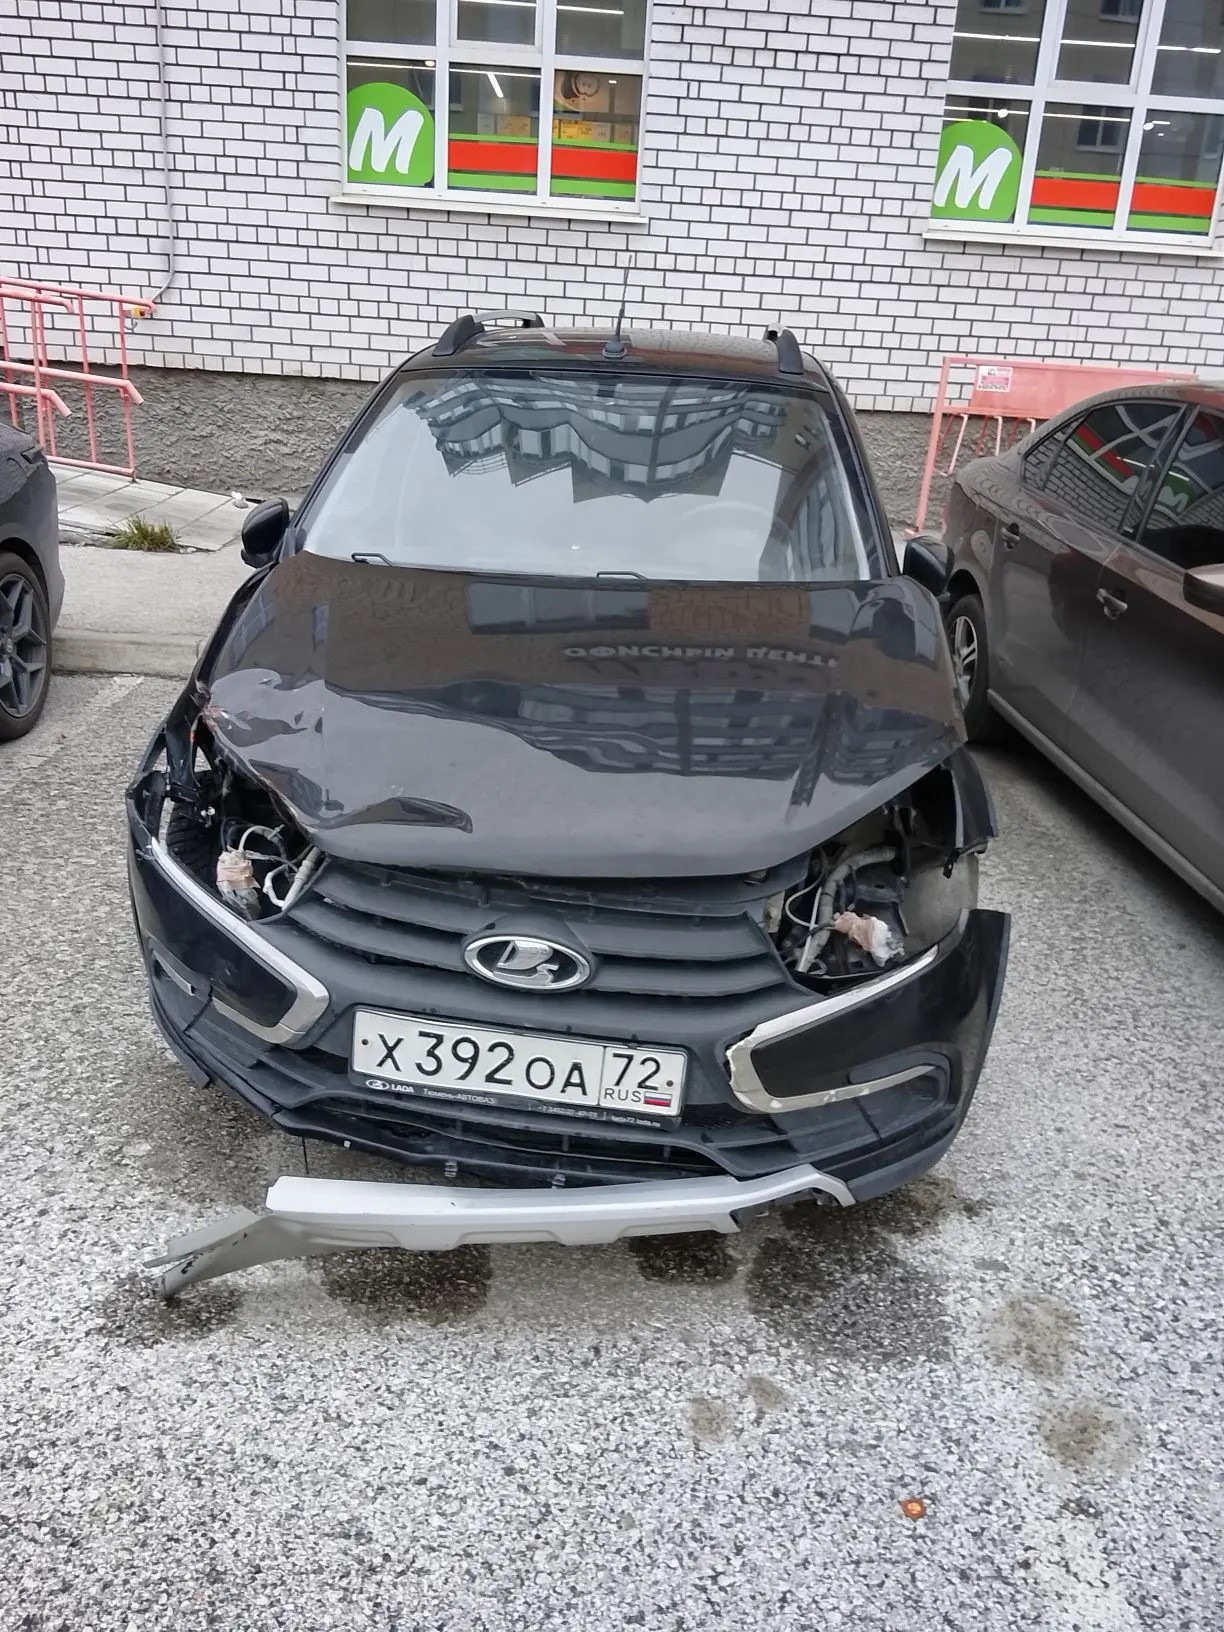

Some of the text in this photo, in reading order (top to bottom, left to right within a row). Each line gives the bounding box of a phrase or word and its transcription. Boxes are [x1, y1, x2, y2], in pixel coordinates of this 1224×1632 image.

[611, 1053, 662, 1091] 72
[391, 1083, 415, 1094] LADA
[603, 1088, 642, 1103] RUS
